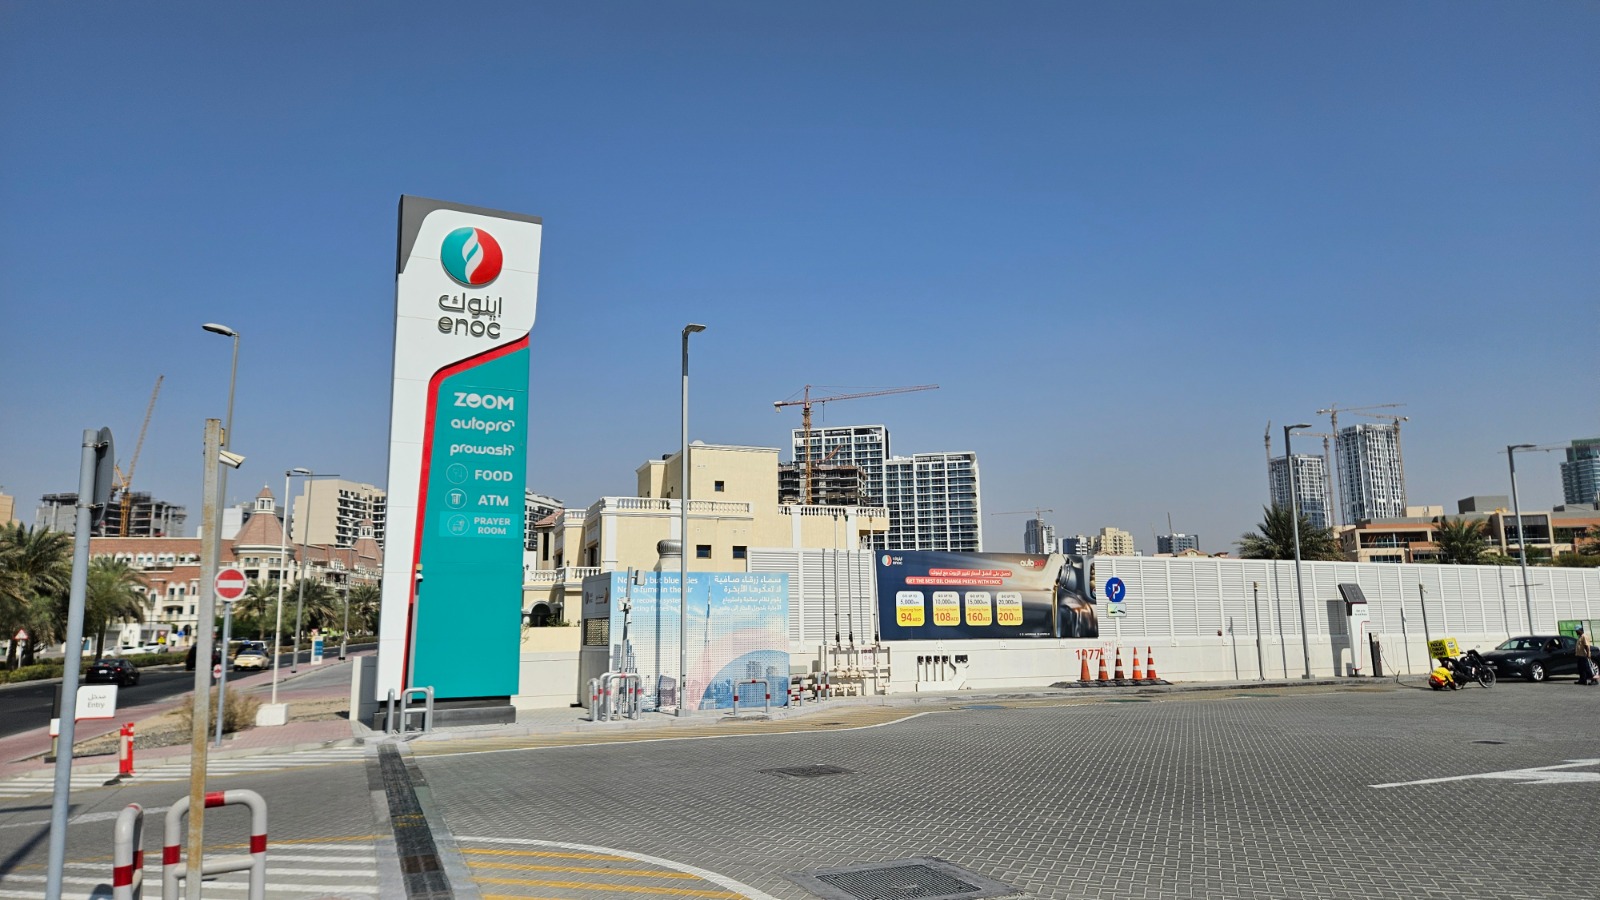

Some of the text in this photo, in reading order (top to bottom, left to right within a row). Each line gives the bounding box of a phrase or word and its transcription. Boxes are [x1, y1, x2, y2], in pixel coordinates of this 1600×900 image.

[438, 316, 501, 339] enoc
[454, 392, 514, 410] ZOOM
[451, 417, 515, 434] autopro
[450, 443, 514, 456] prowash
[474, 469, 513, 482] FOOD
[478, 494, 509, 506] ATM
[474, 517, 510, 526] PRAYER
[478, 526, 506, 535] ROOM
[617, 576, 648, 586] Nohg
[663, 576, 680, 584] blue
[1112, 583, 1120, 600] P
[901, 612, 912, 622] 94
[935, 612, 951, 621] 108
[967, 612, 983, 621] 160
[998, 612, 1014, 621] 200
